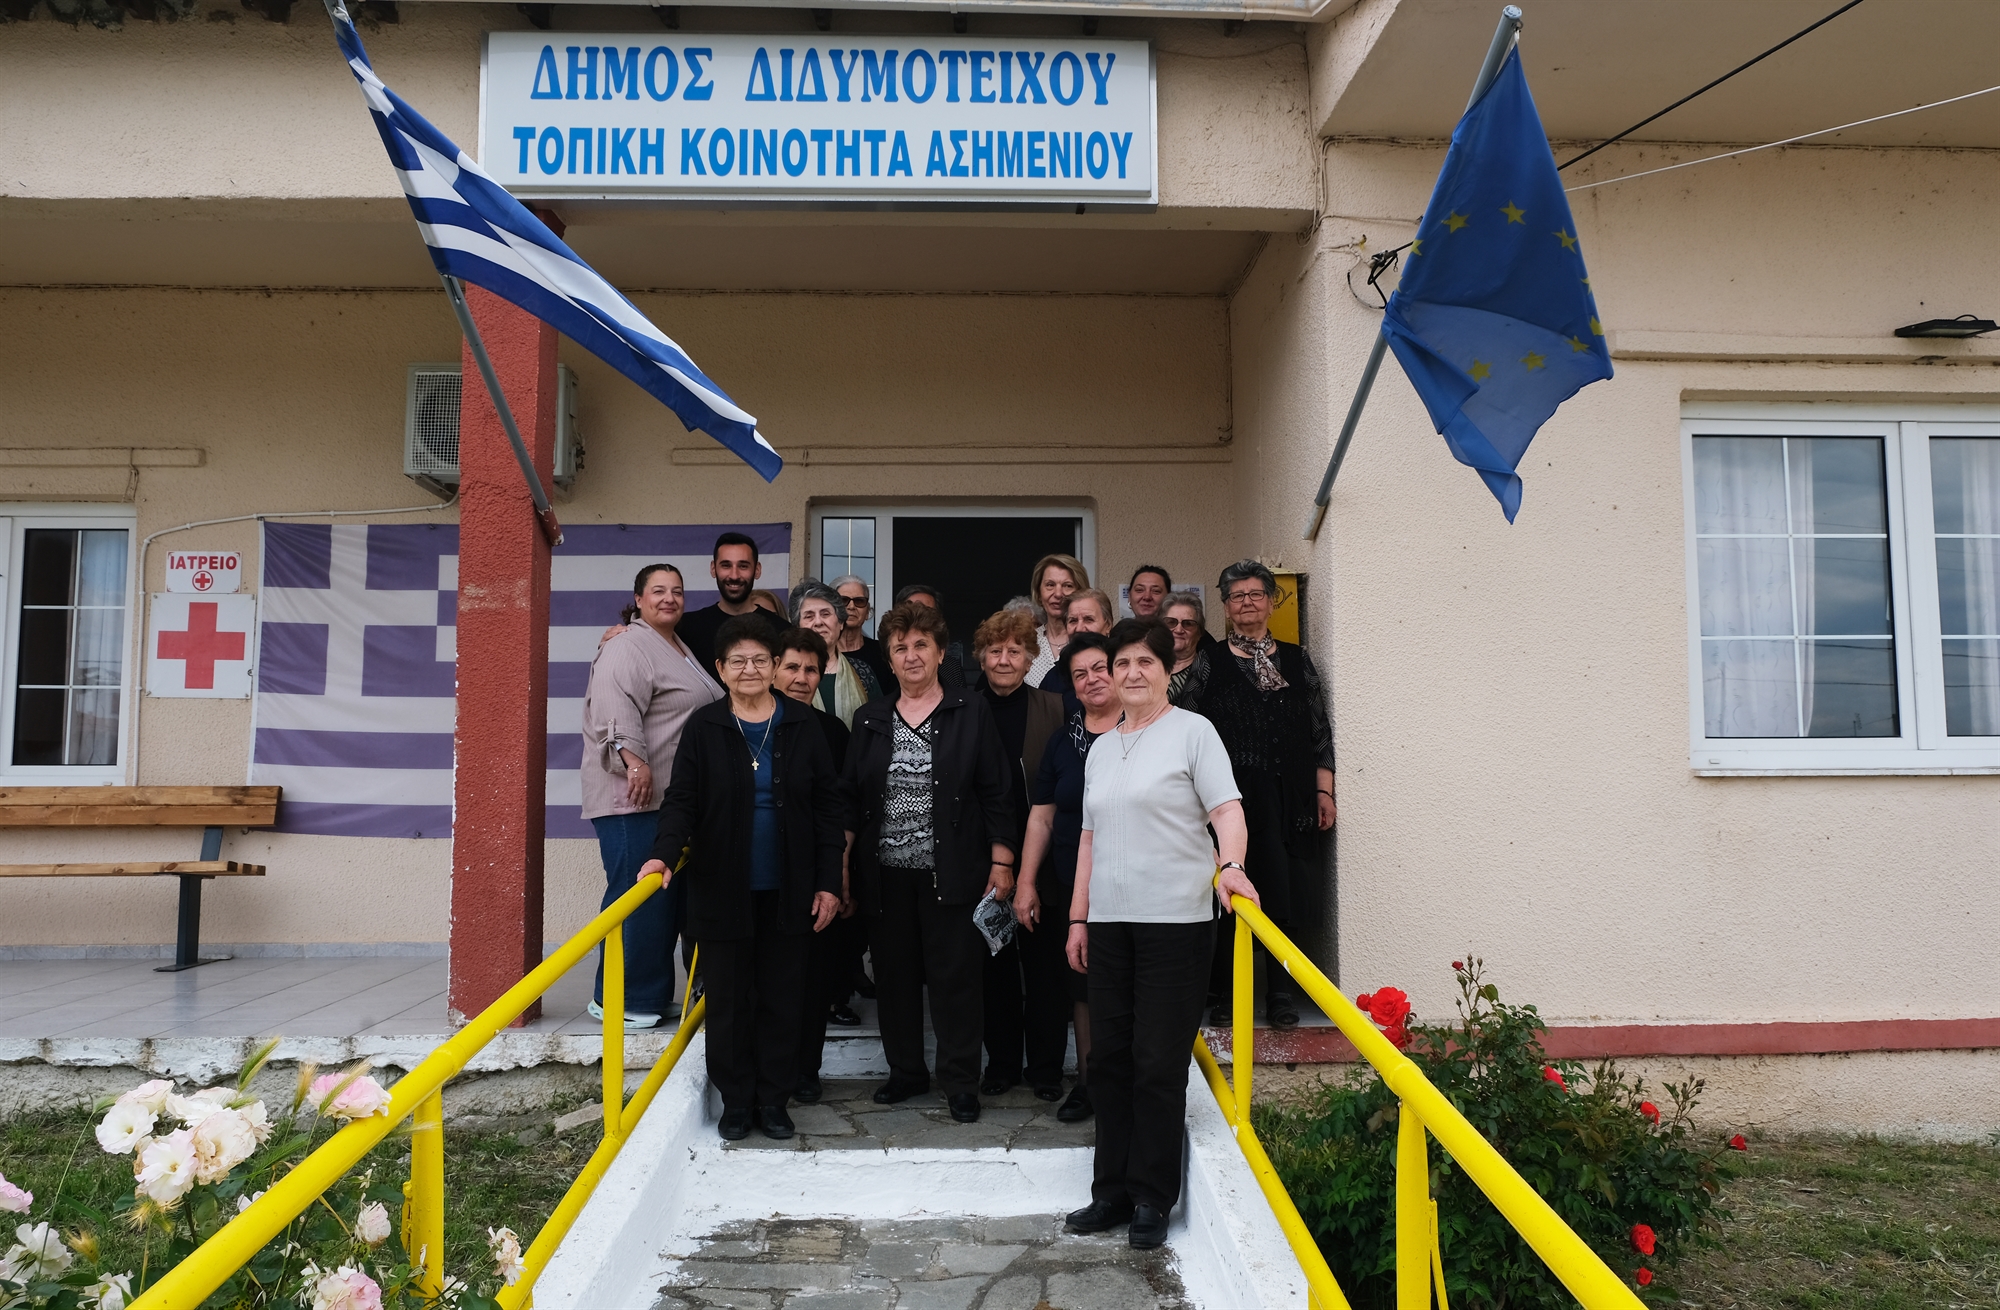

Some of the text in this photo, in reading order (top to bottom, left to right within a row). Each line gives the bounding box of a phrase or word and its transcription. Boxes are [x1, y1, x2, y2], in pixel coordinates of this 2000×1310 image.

[529, 44, 1116, 107] ΔΗΜΟΣ ΔΙΔΥΜΟΤΕΙΧΟΥ
[512, 125, 1134, 181] ΤΟΠΙΚΗ ΚΟΙΝΟΤΗΤΑ ΑΣΗΜΕΝΙΟΥ
[170, 556, 237, 570] ΙΑΤΡΕΙΟ
